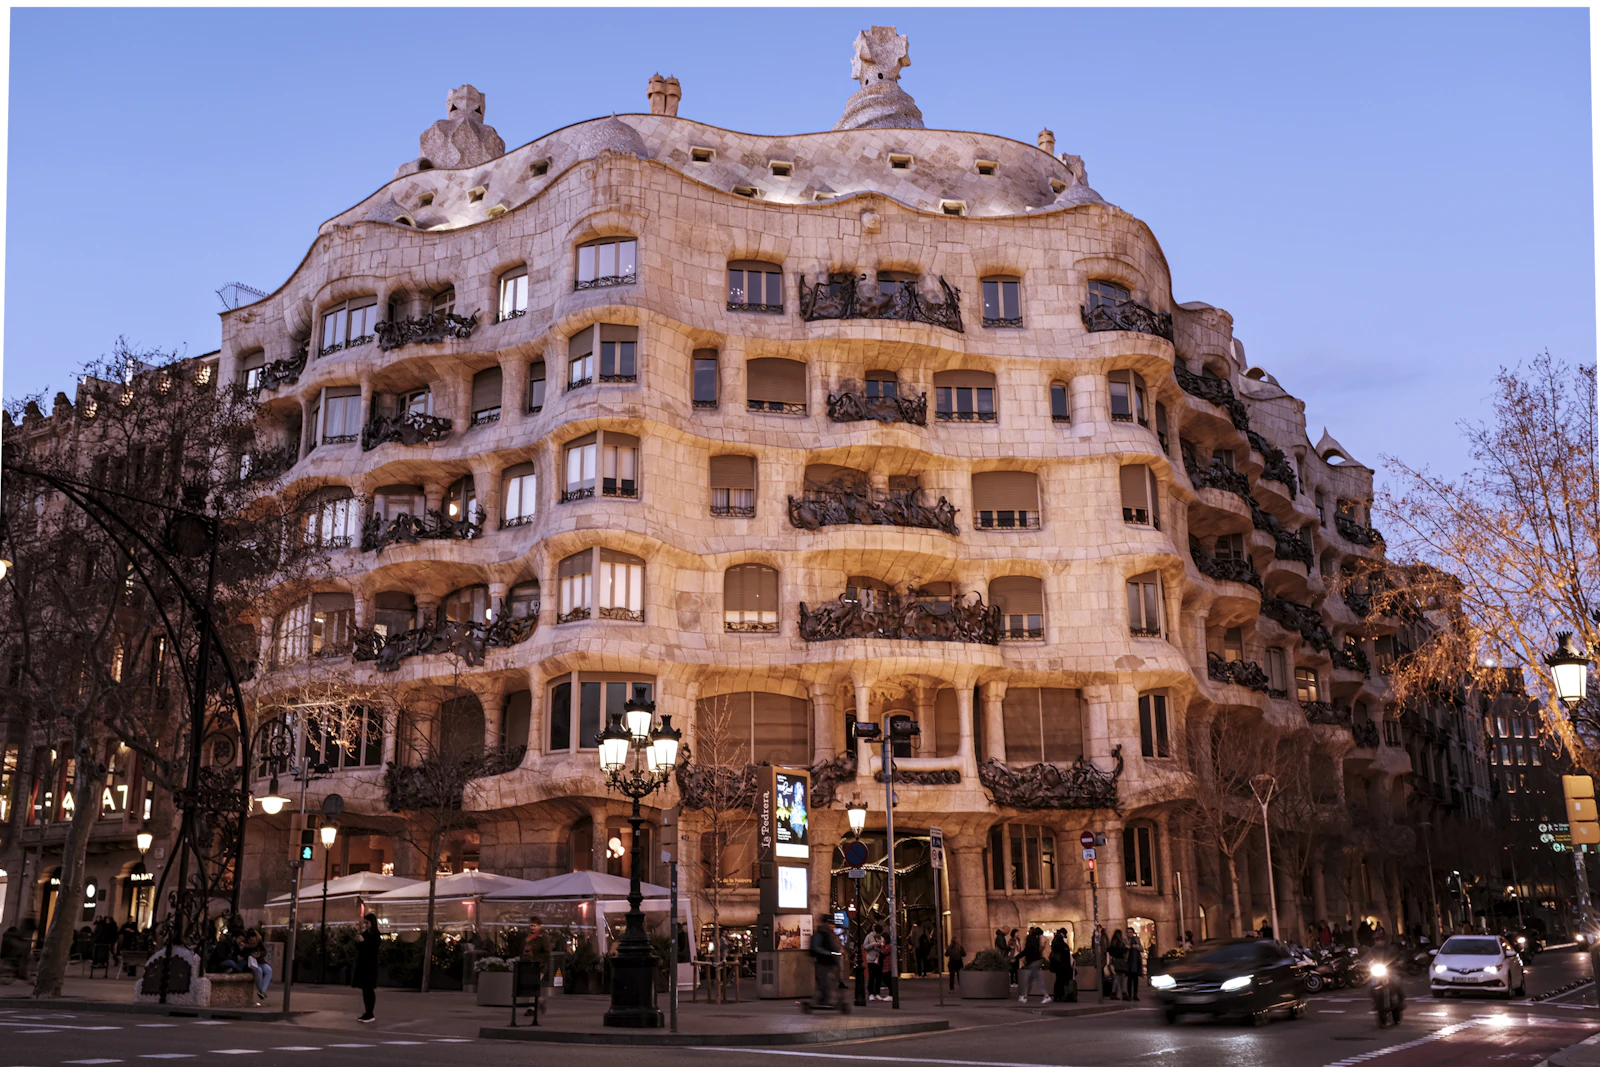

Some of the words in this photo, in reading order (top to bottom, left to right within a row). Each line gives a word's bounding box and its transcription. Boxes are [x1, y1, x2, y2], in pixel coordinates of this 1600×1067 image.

[761, 791, 770, 836] Pedrera
[762, 837, 771, 848] La
[131, 873, 154, 881] RABAT
